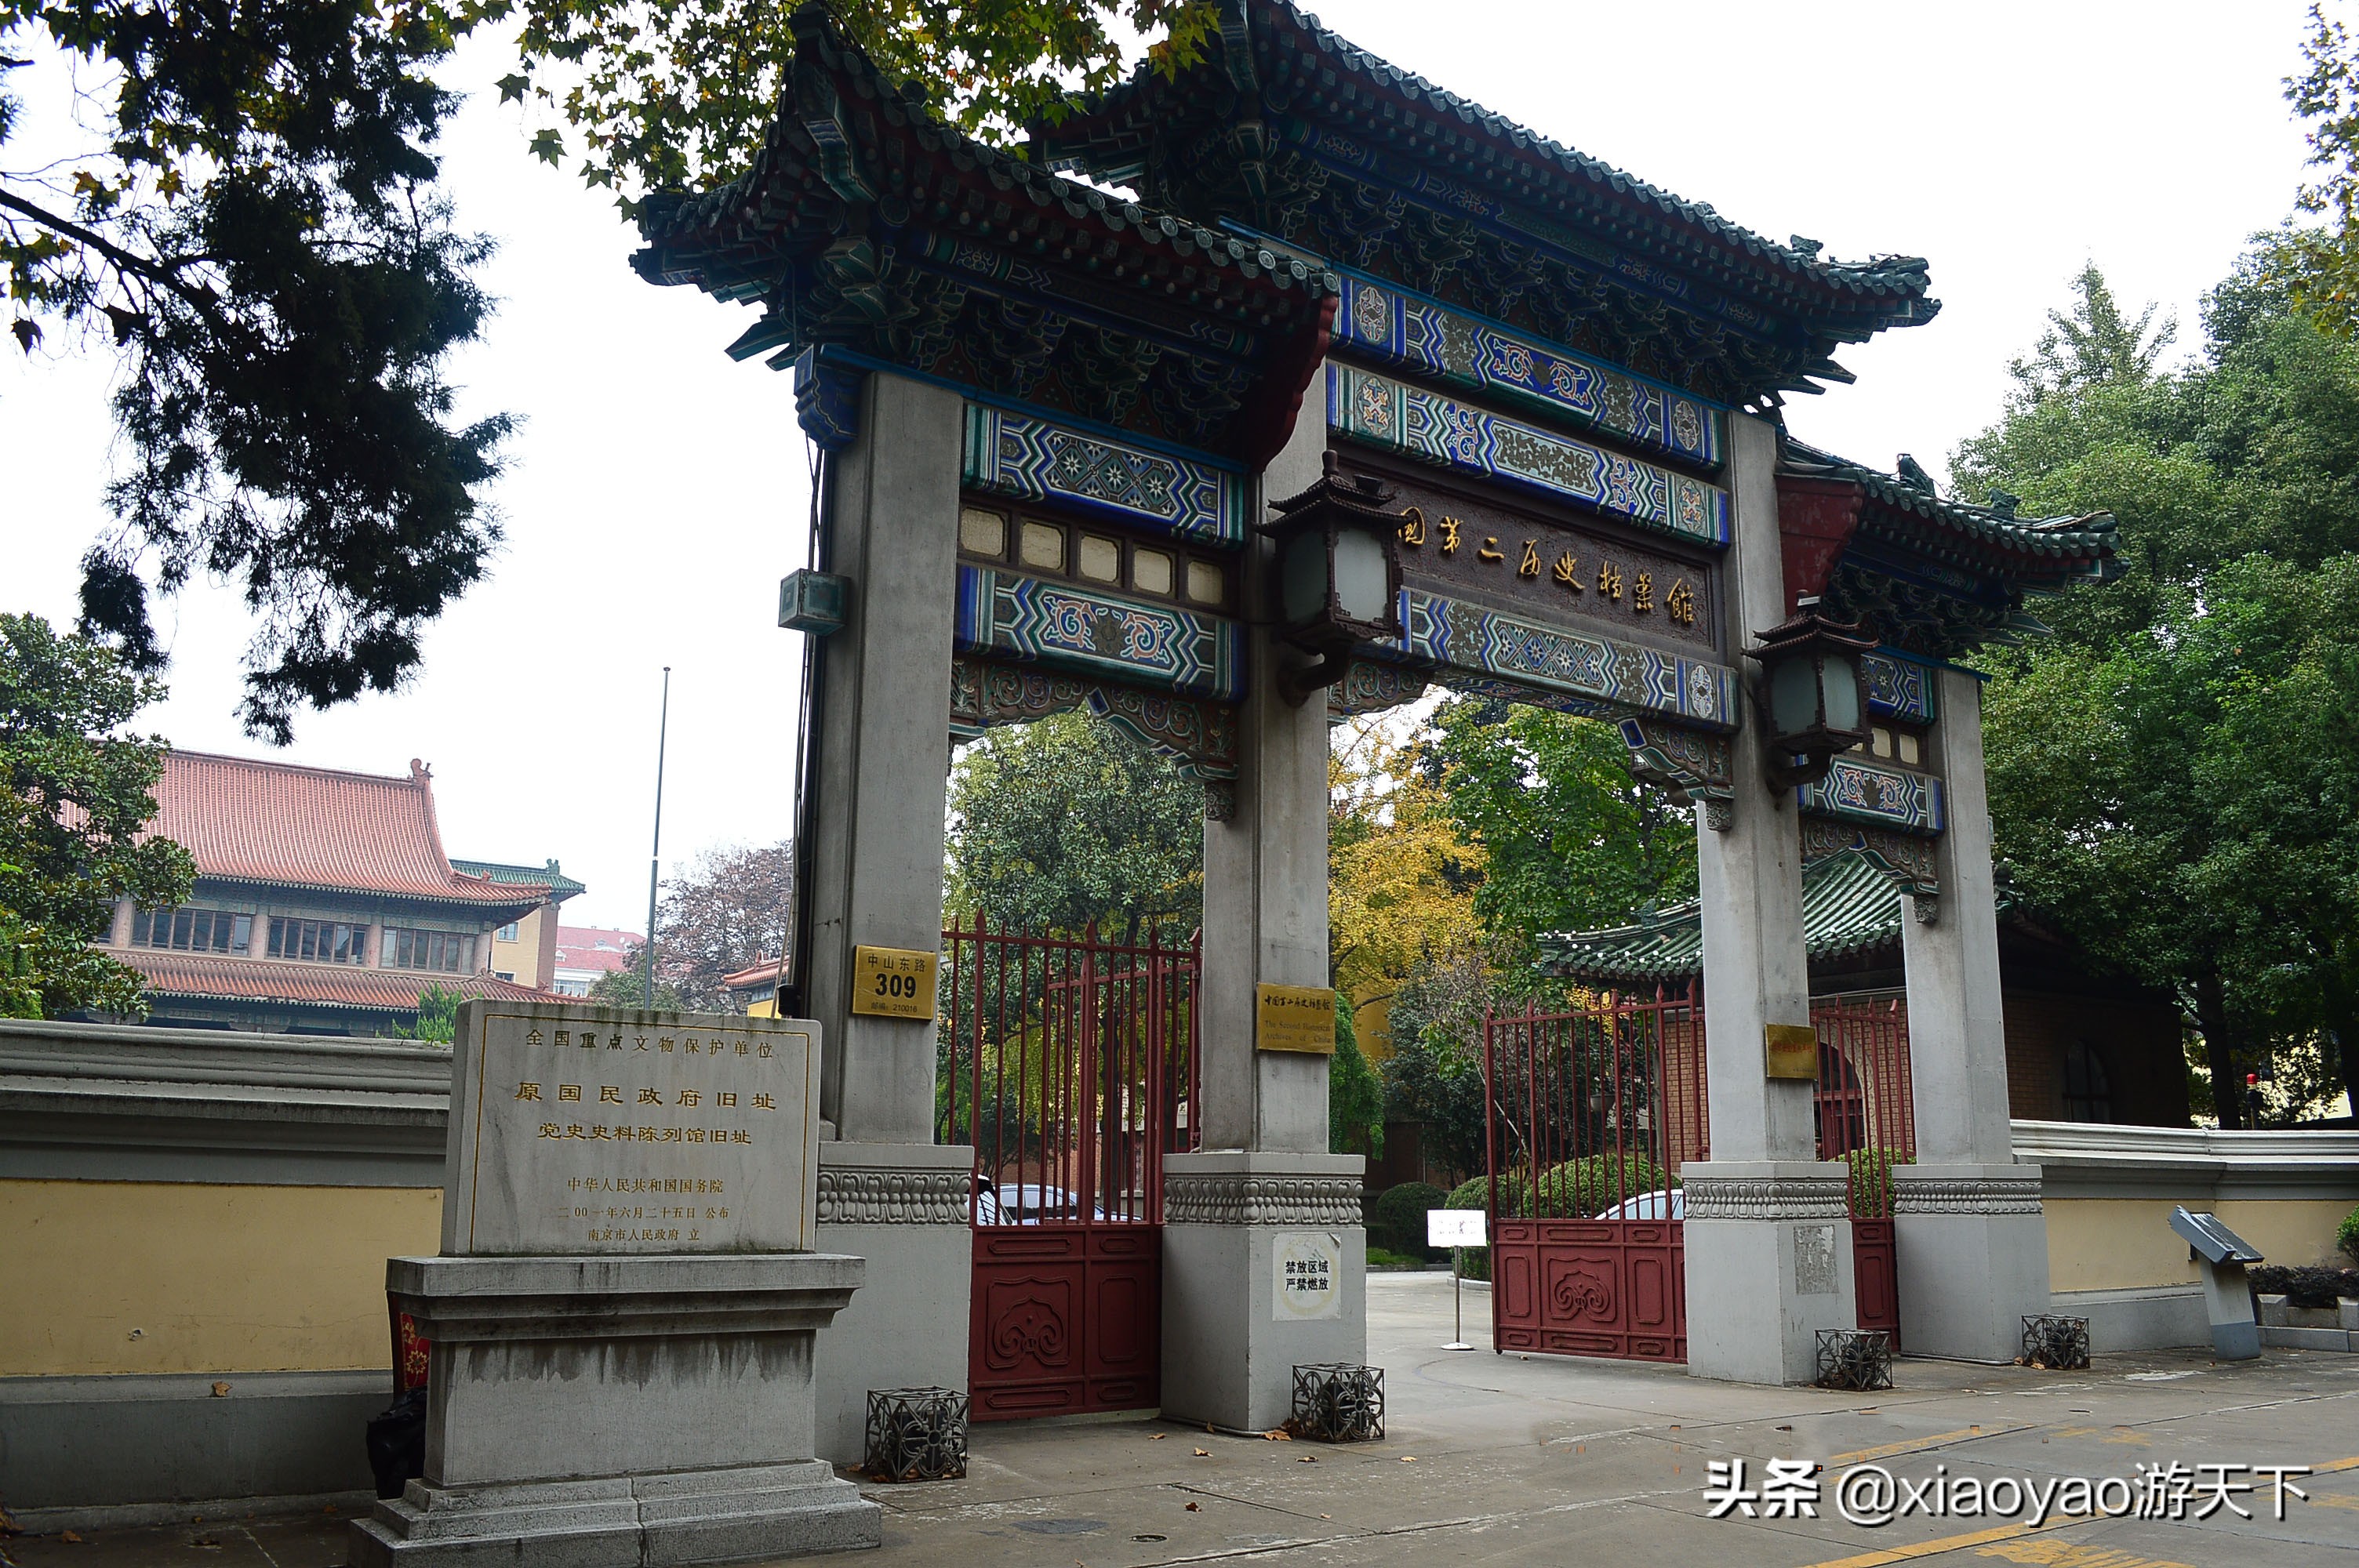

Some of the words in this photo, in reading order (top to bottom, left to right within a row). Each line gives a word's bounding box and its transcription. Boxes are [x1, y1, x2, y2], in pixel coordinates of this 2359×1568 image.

[867, 953, 925, 973] 中山东路
[874, 973, 916, 999] 309
[525, 1029, 774, 1058] 全国重点文物保护单位
[514, 1082, 777, 1111] 原国民政府旧址
[536, 1122, 753, 1145] 党史史料陈列馆旧址
[566, 1177, 725, 1194] 中华人民共和国国务院
[587, 1228, 681, 1242] 南京市人民政府
[1285, 1260, 1329, 1275] 禁放区域
[1285, 1277, 1329, 1292] 严禁燃放
